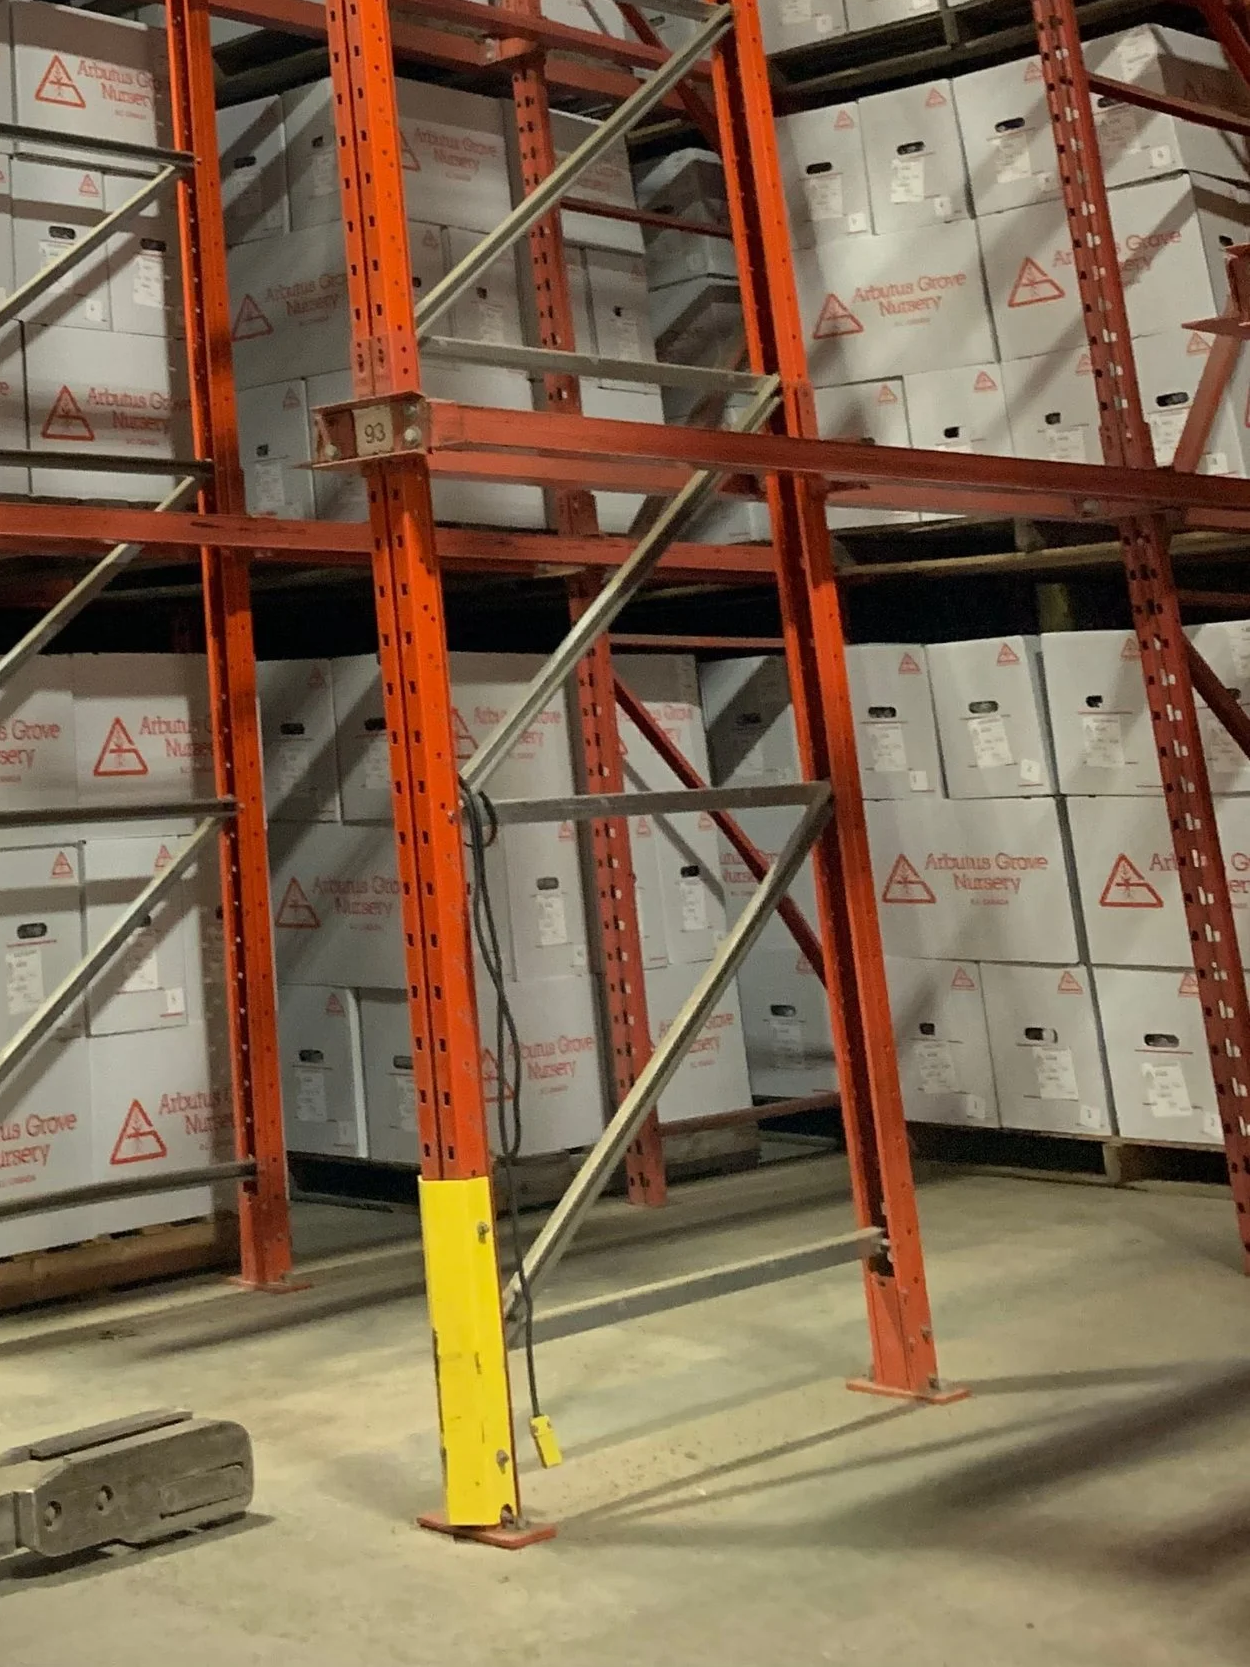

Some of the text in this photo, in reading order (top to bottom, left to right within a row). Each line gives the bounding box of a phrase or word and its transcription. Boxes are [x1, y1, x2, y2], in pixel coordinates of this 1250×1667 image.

[77, 59, 133, 85] Arbutus
[851, 274, 968, 303] Arbutus Grove
[878, 295, 943, 317] Nursery
[87, 387, 147, 409] Arbutus
[363, 421, 387, 444] 93
[11, 719, 61, 740] Grove
[924, 851, 1049, 872] Arbutus Grove
[312, 875, 401, 895] Arbutus Gro
[953, 872, 1022, 895] Nursery
[334, 895, 394, 920] Nursery
[557, 1035, 595, 1054] Grove
[526, 1060, 577, 1080] Nursery
[25, 1114, 77, 1137] Grove
